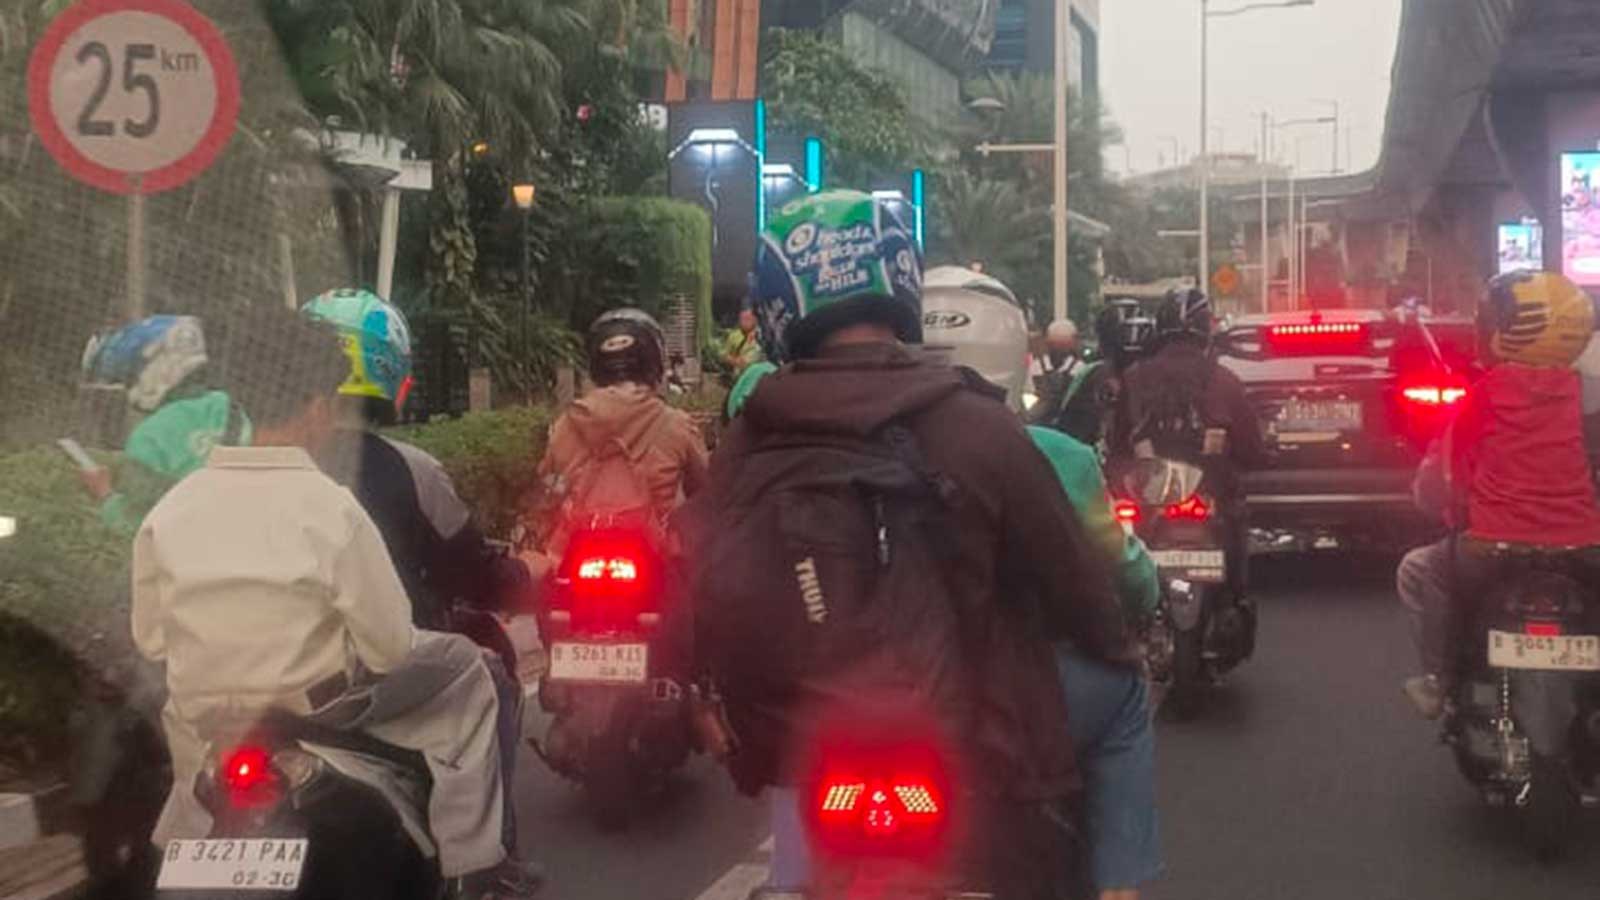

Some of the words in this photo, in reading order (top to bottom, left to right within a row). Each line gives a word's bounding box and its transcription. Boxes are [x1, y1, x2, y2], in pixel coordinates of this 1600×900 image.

[77, 42, 160, 138] 25
[161, 47, 198, 71] km
[167, 841, 182, 862] B
[191, 841, 248, 862] 3421
[258, 840, 302, 862] PAA
